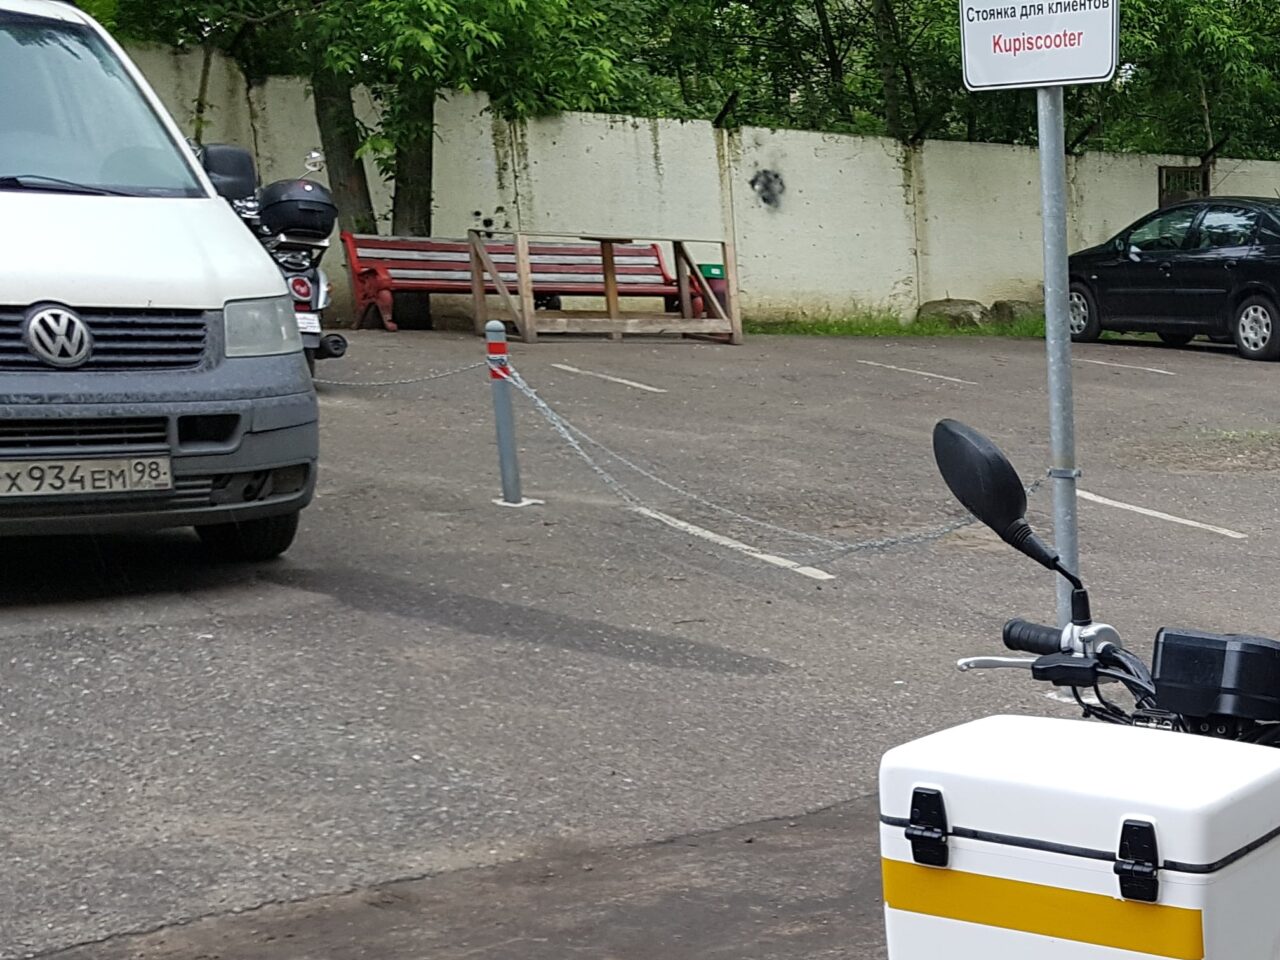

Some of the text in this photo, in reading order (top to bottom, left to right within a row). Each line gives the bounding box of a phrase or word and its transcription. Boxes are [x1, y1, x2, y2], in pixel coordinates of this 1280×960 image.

[966, 0, 1110, 22] Стоянка для клиентов
[992, 29, 1084, 56] Kupiscooter
